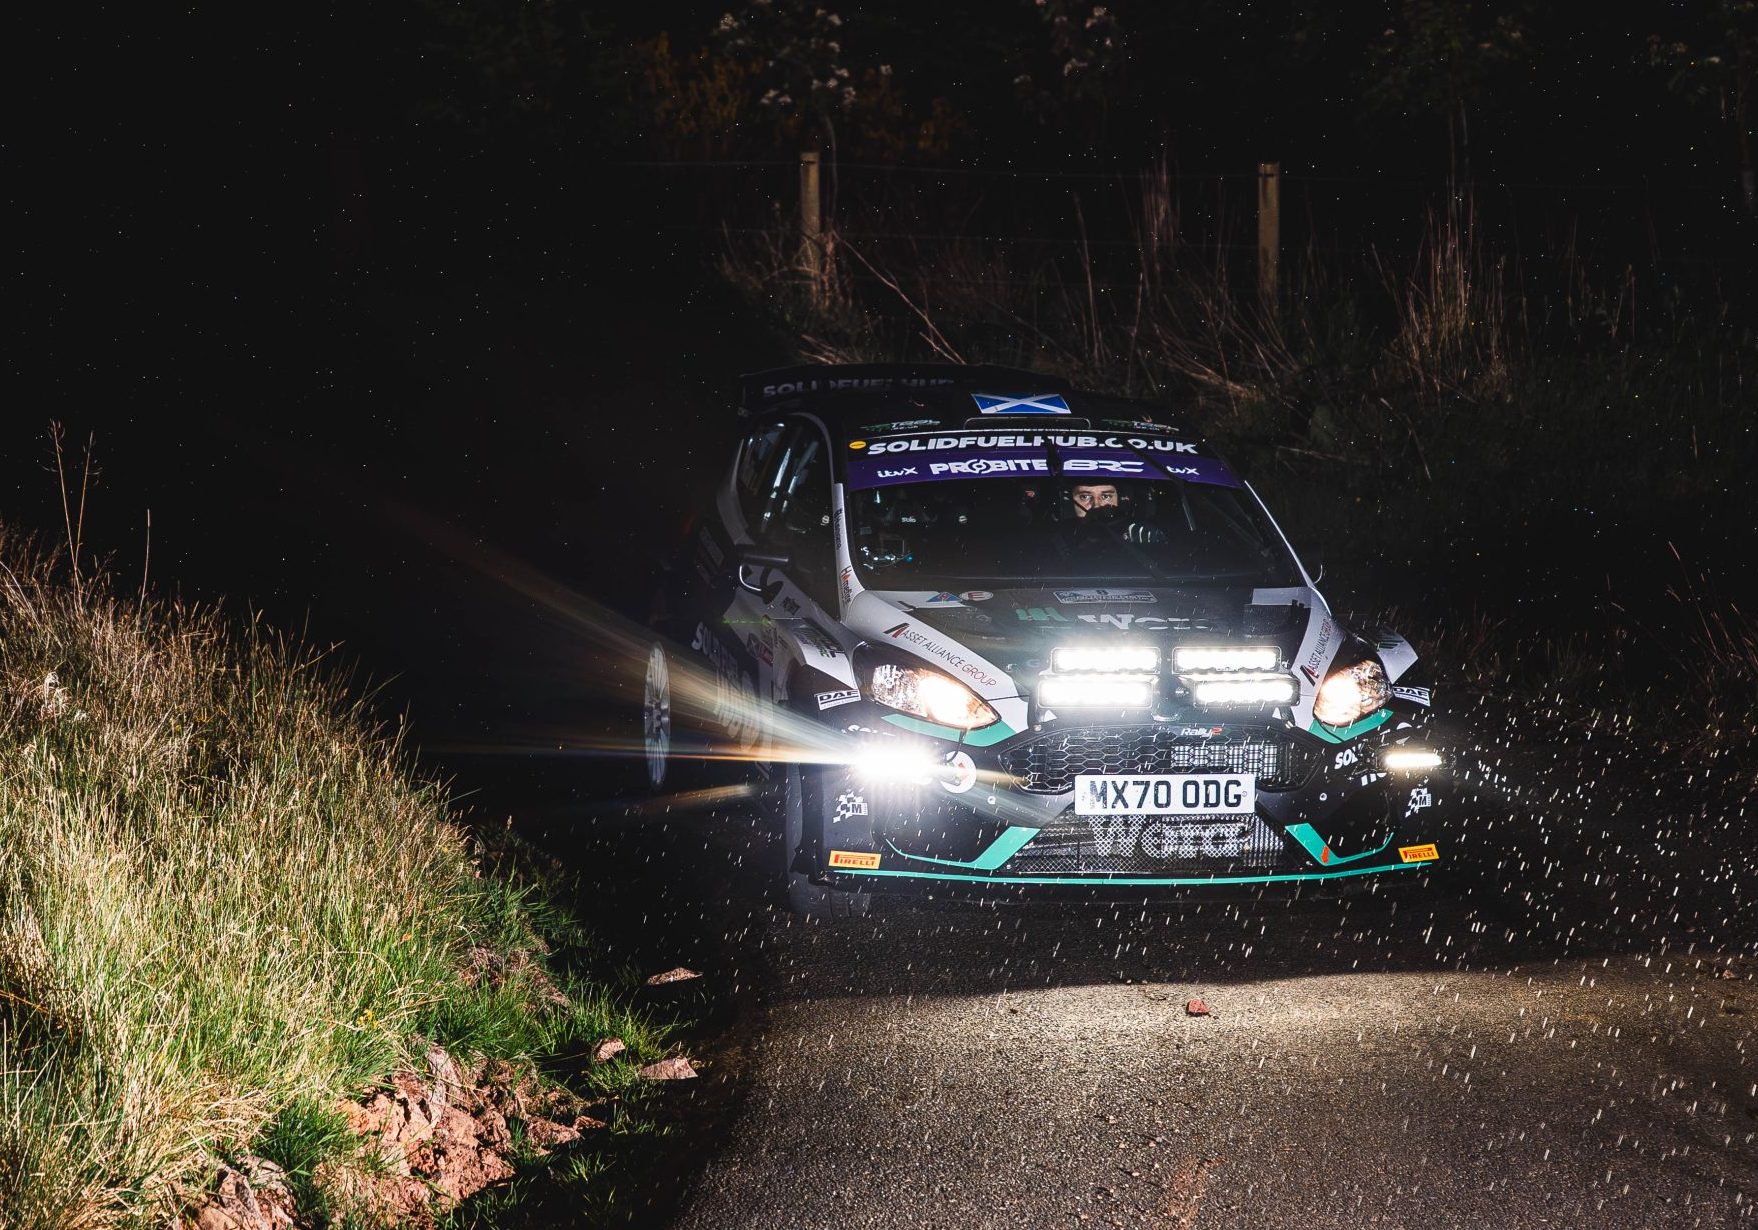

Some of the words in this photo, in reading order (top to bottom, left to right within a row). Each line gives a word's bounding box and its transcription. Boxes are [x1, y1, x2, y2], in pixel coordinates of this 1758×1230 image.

[867, 435, 1198, 455] SOLIDFUELHUB.CO.UK
[929, 459, 1049, 475] PROBITE
[1063, 459, 1144, 473] BRC
[1166, 465, 1200, 476] tvX
[902, 629, 927, 646] ASSET
[923, 640, 965, 668] ALLIANCE
[961, 663, 997, 687] GROUP
[819, 690, 858, 702] DAF
[1393, 687, 1428, 697] DAF
[1180, 727, 1223, 741] Rally2
[1089, 780, 1172, 810] MX70
[1182, 779, 1242, 809] ODG
[833, 854, 876, 866] PIRELLI
[1402, 848, 1435, 860] PIRELLI
